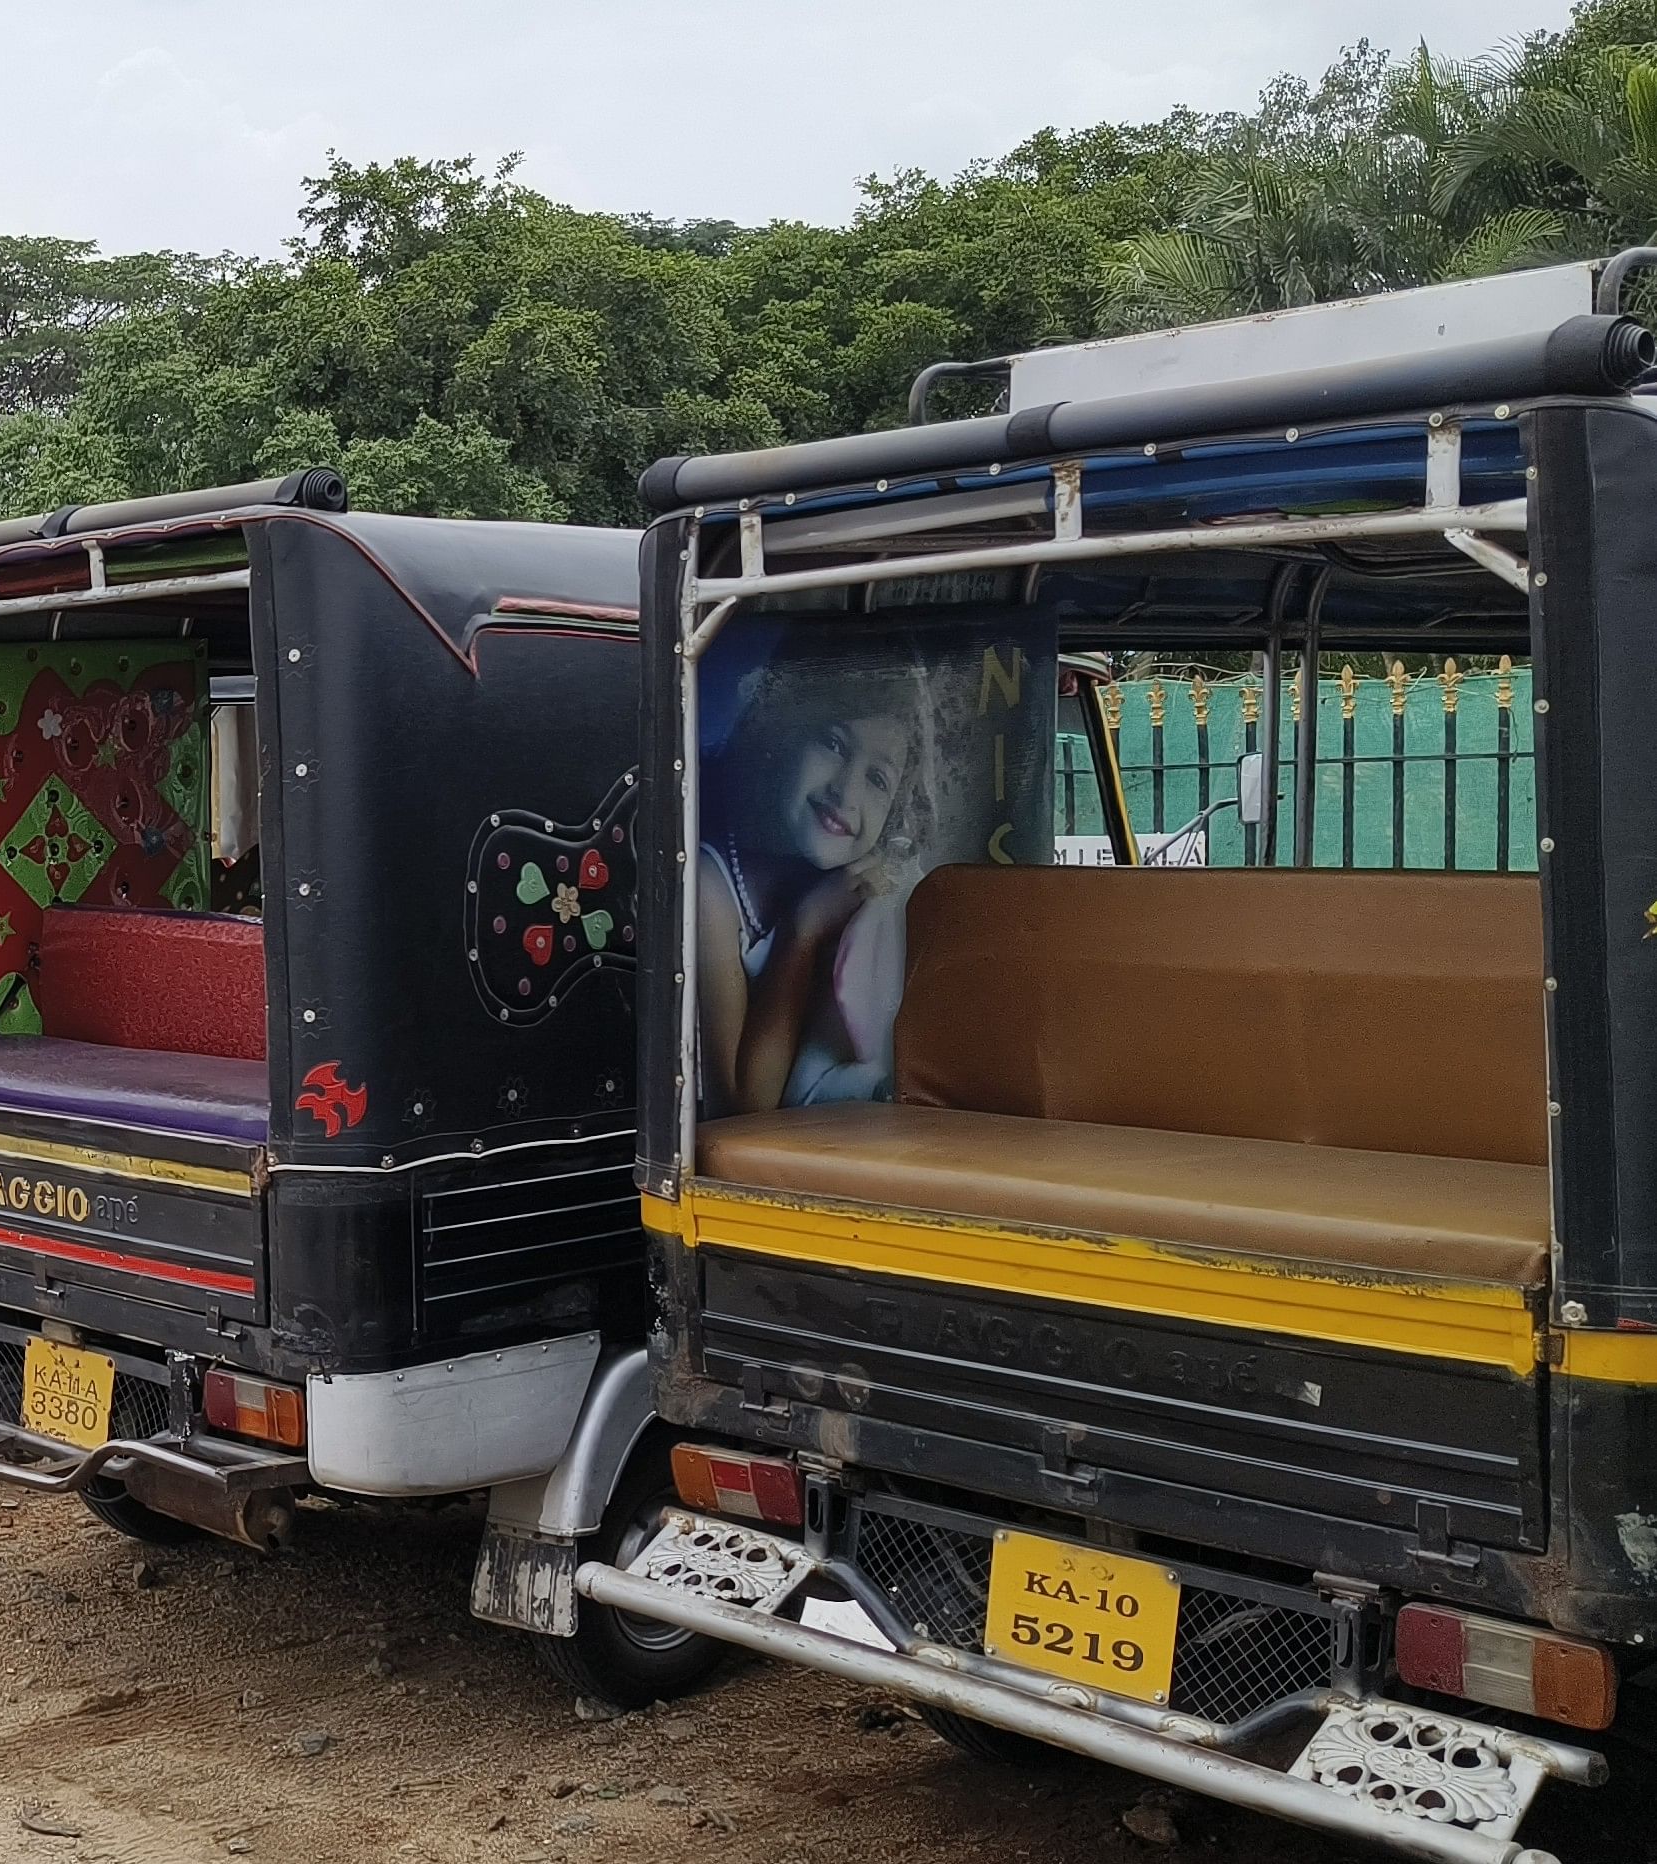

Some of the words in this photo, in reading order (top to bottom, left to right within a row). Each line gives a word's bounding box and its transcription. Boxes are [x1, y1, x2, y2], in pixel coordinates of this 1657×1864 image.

[31, 1391, 97, 1431] 3380
[1024, 1570, 1139, 1618] KA-10
[1011, 1613, 1144, 1672] 5219
